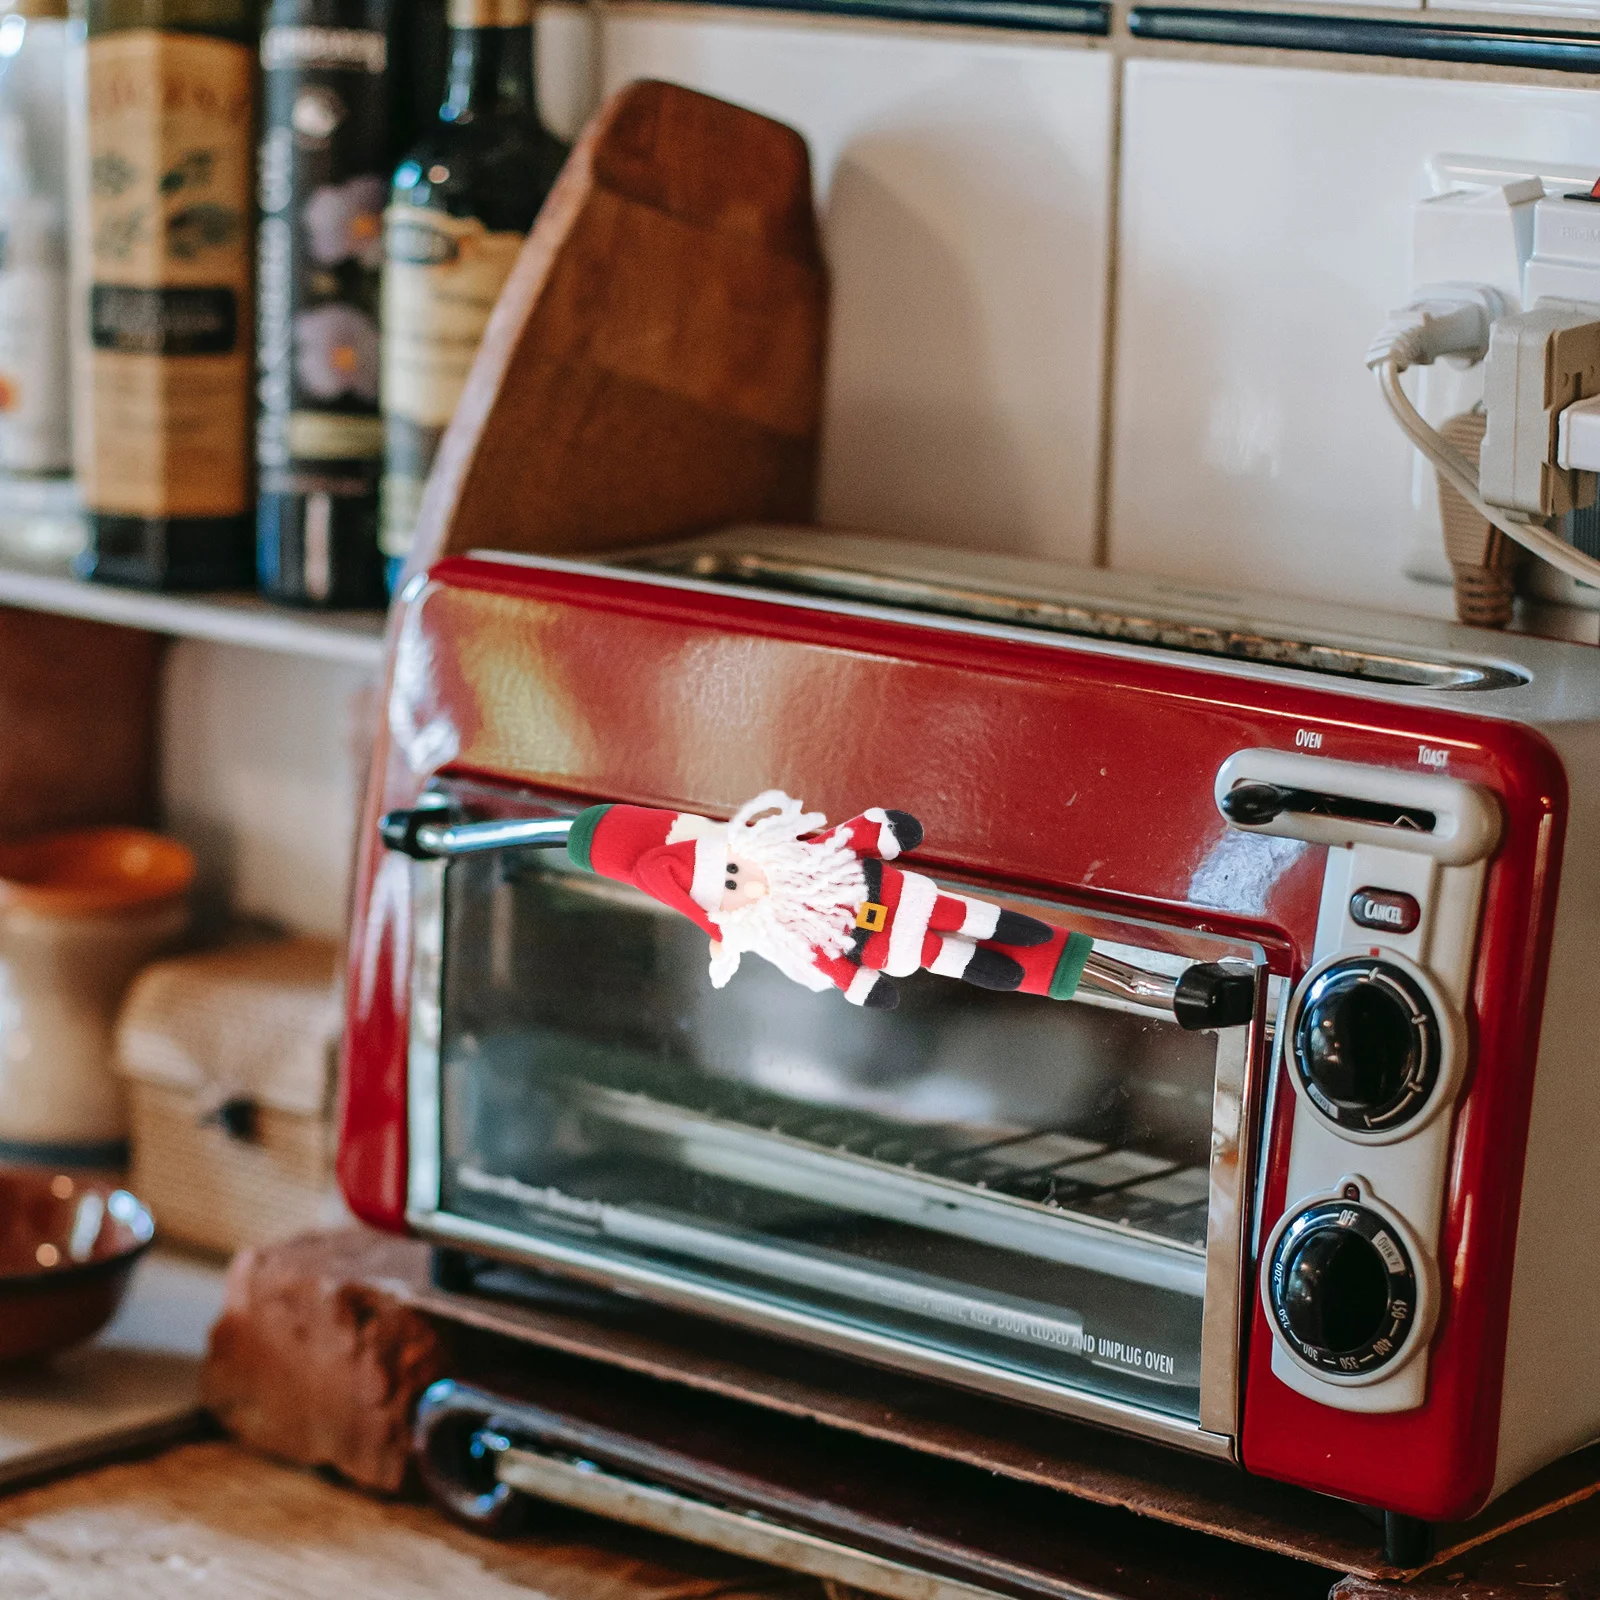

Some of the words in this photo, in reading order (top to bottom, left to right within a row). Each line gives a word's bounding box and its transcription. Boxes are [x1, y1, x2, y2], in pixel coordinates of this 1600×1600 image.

[1295, 729, 1323, 749] OVEN
[1418, 745, 1449, 767] TOAST
[1364, 900, 1402, 924] CANCEL
[1339, 1209, 1358, 1225] OFF
[1377, 1236, 1395, 1259] OVEN
[1274, 1262, 1284, 1284] 200
[1279, 1308, 1290, 1329] 250
[997, 1312, 1028, 1335] DOOR
[1030, 1322, 1069, 1346] CLOSED
[1072, 1331, 1095, 1353] AND
[1098, 1338, 1142, 1366] UNPLUG
[1144, 1351, 1174, 1375] OVEN
[1302, 1343, 1318, 1361] 300
[1373, 1338, 1392, 1355] 400
[1339, 1356, 1359, 1370] 350
